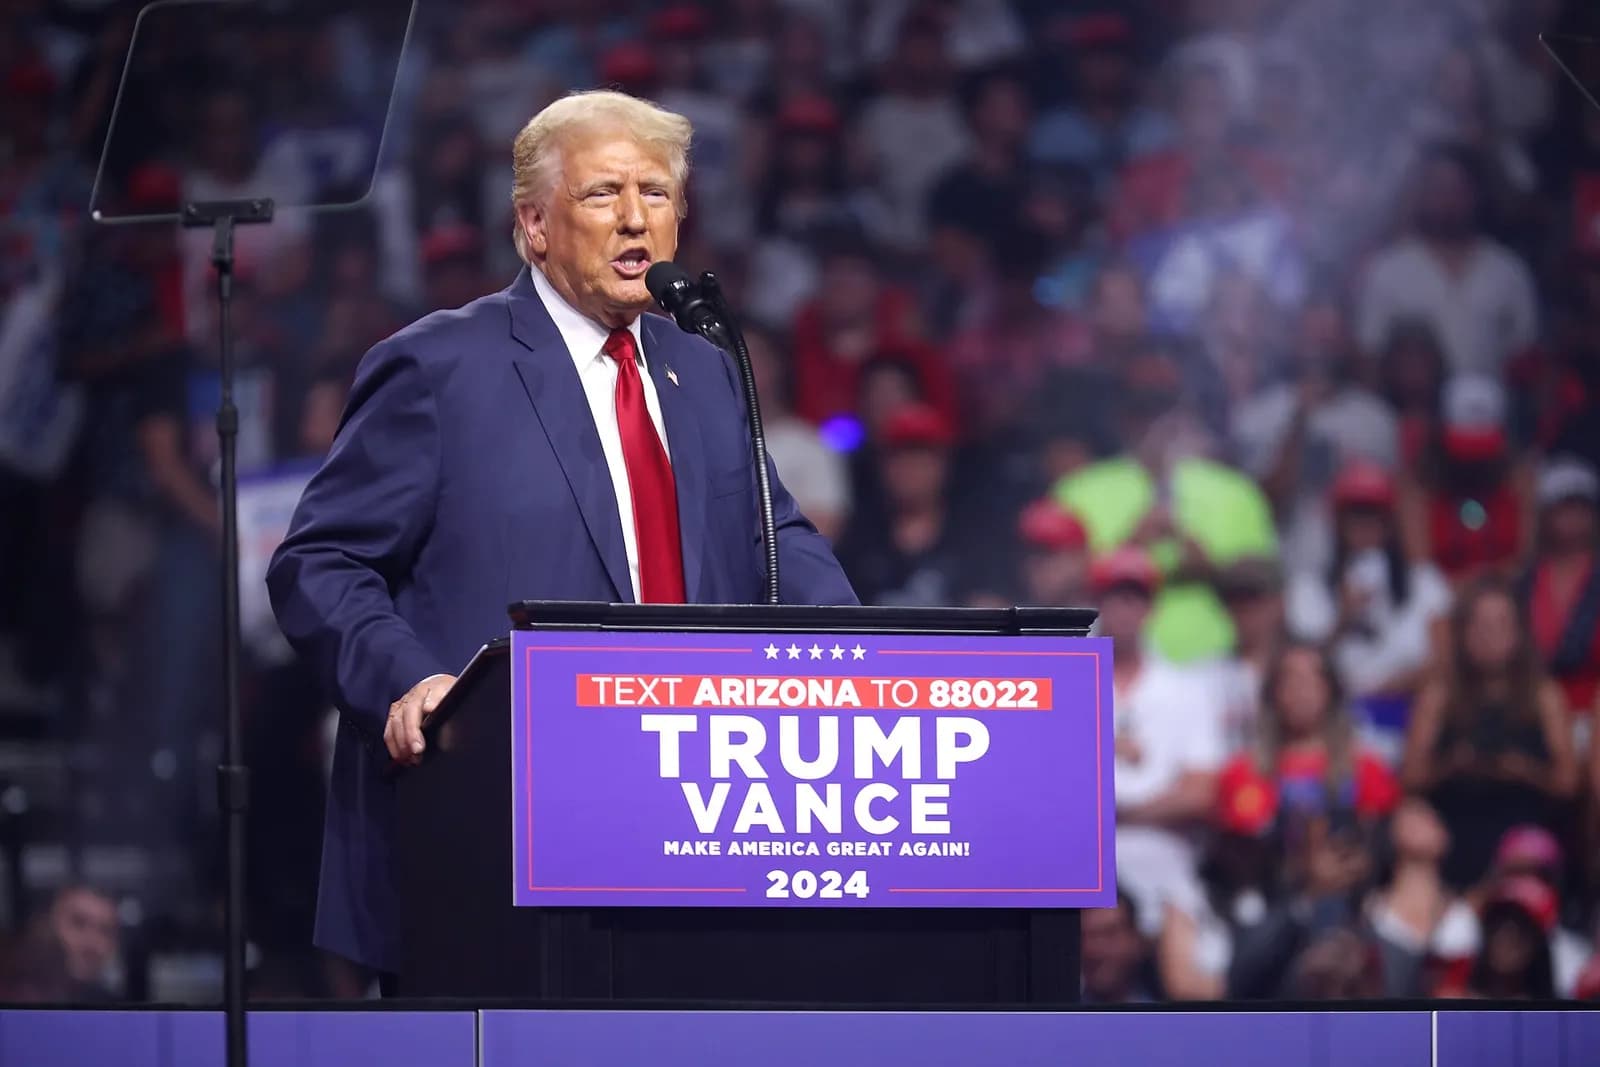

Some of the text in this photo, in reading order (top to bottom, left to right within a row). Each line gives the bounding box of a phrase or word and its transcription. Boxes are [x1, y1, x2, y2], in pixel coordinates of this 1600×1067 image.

[591, 676, 1038, 708] TEXT ARIZONA TO 88022
[640, 714, 990, 780] TRUMP
[680, 782, 951, 835] VANCE
[663, 840, 970, 857] MAKE AMERICA GREAT AGAIN!
[766, 869, 870, 899] 2024
